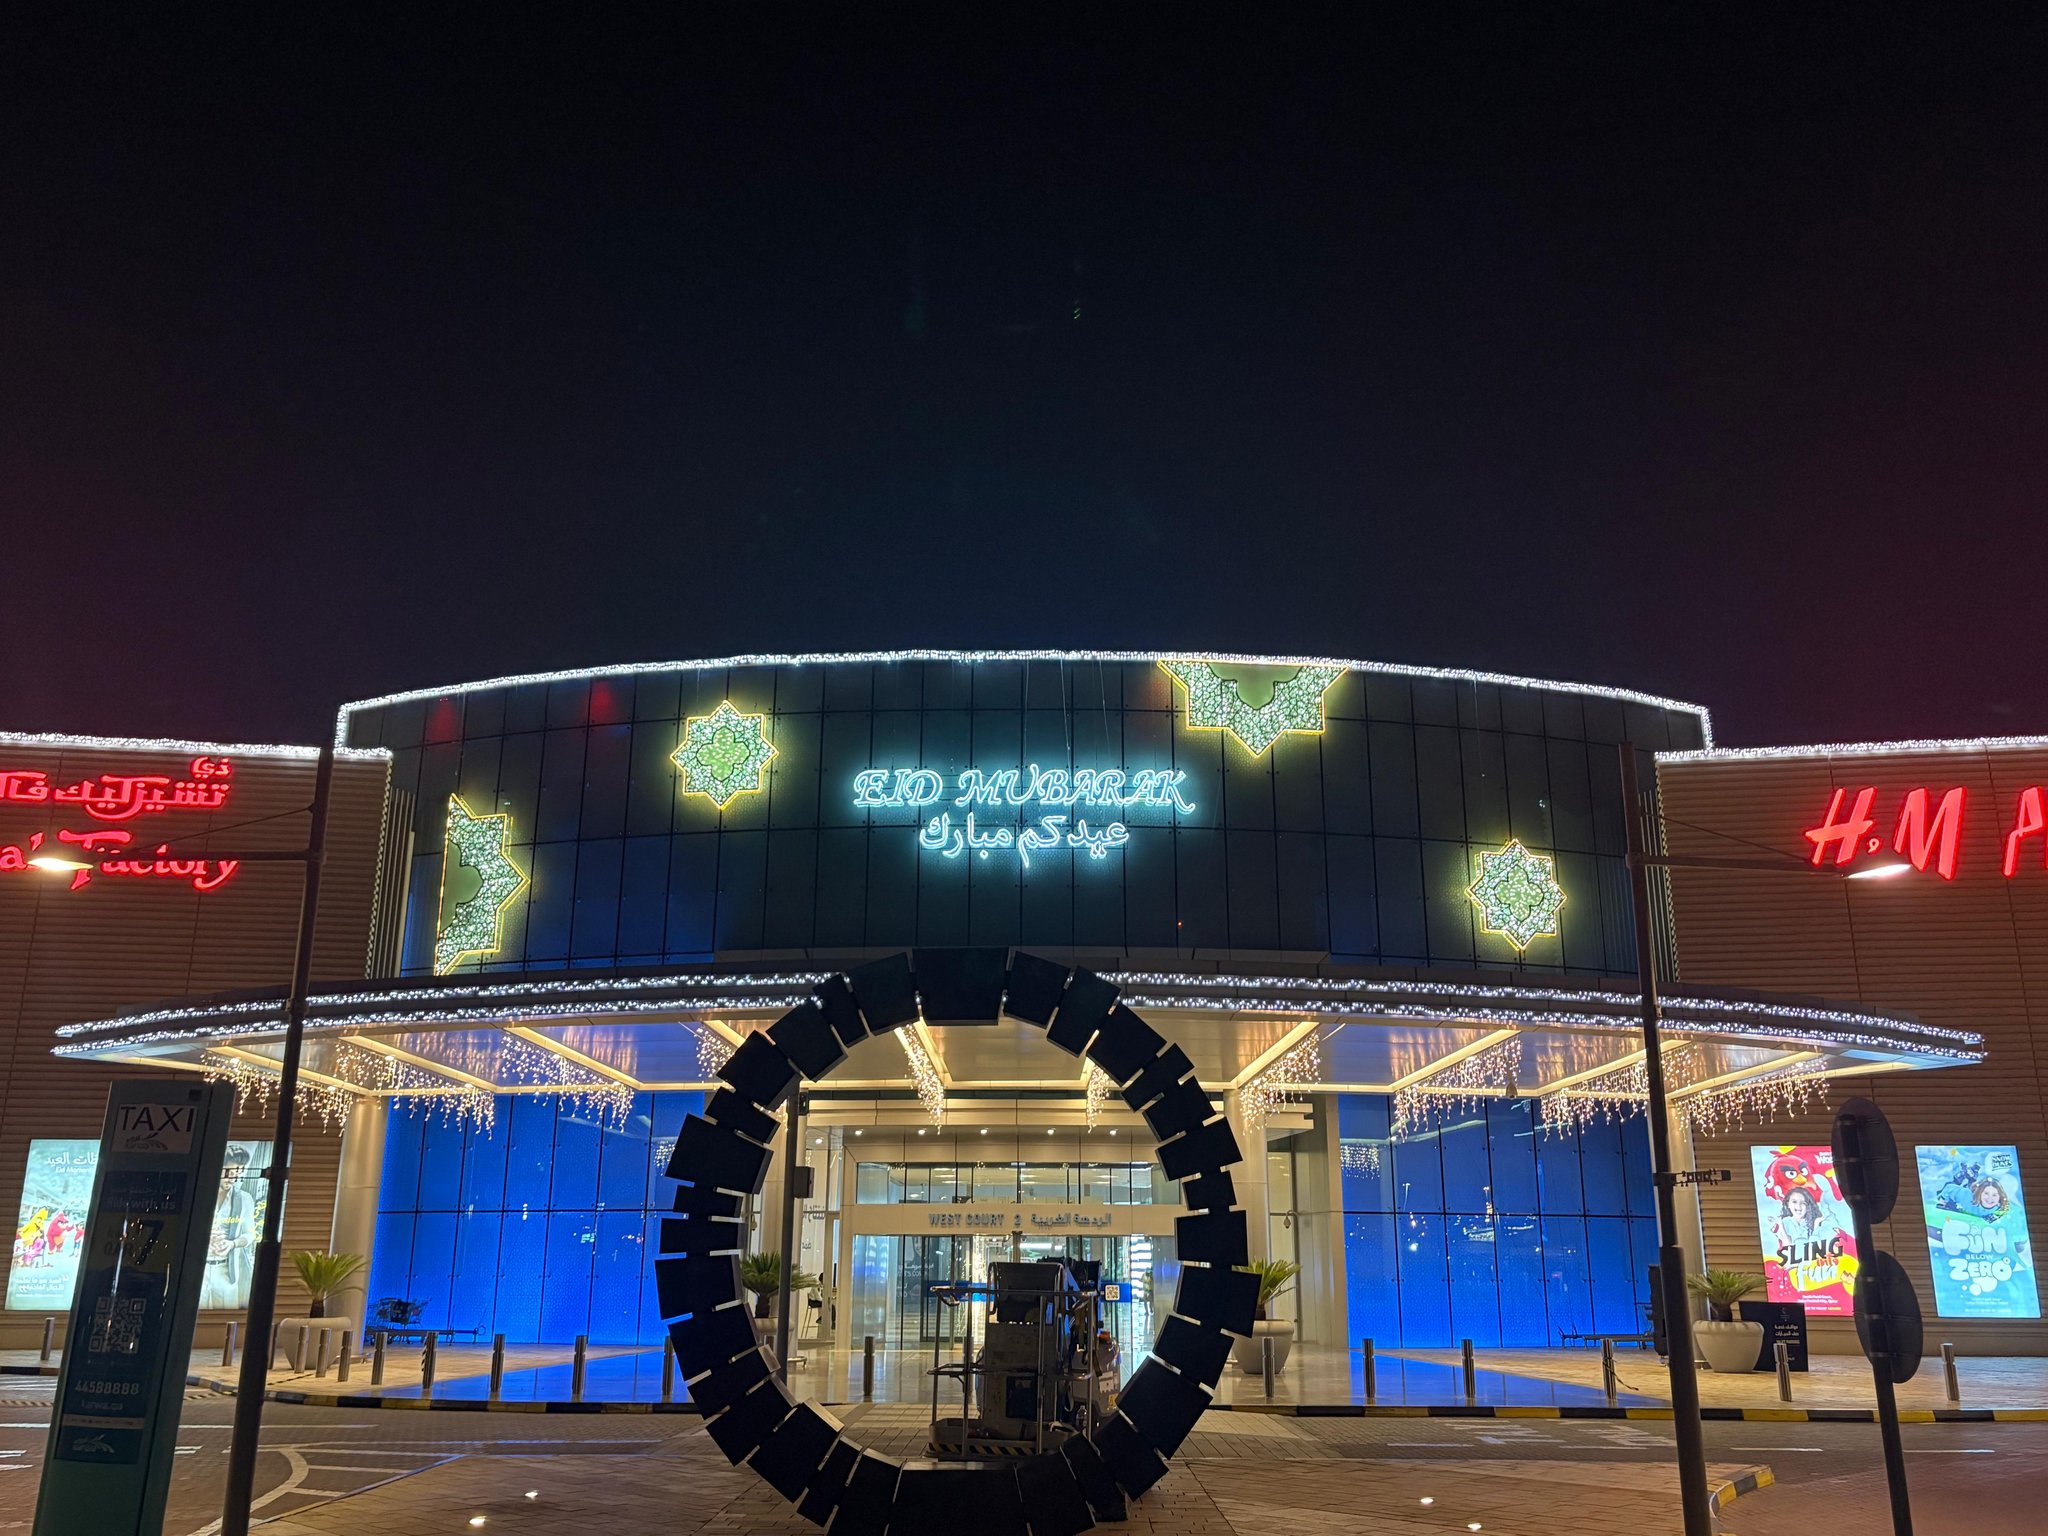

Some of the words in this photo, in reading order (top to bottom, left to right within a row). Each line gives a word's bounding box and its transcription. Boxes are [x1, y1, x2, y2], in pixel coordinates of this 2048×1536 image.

[53, 774, 231, 820] تشيزكيك
[853, 768, 943, 807] EID
[956, 764, 1195, 815] MUBARAK
[918, 812, 1013, 859] مبارك
[120, 1106, 195, 1133] TAXI
[161, 1200, 176, 1209] us
[928, 1213, 961, 1226] WEST
[966, 1213, 1005, 1226] COURT
[1014, 1213, 1022, 1226] 2
[1776, 1236, 1844, 1267] SLING
